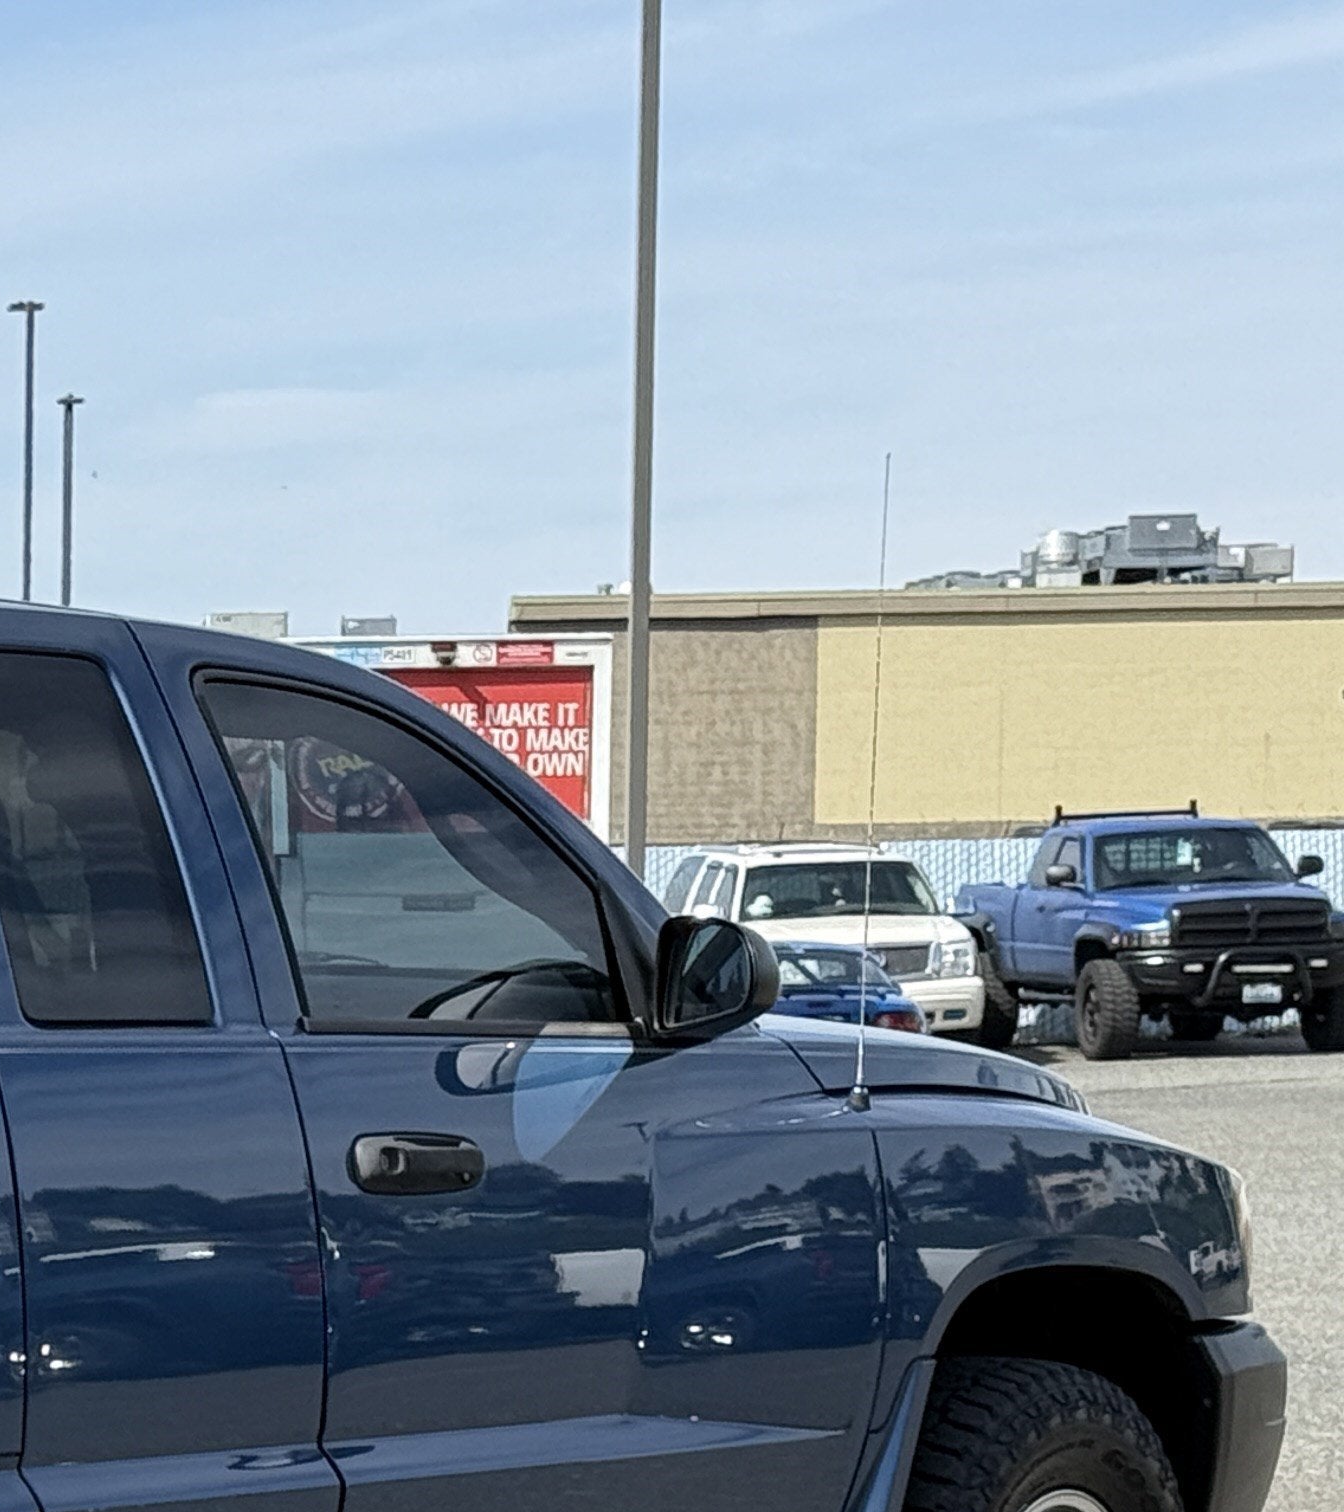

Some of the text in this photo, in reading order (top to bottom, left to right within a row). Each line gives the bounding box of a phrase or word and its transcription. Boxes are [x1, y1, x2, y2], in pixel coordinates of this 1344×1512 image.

[441, 702, 580, 727] WE MAKE IT
[488, 728, 520, 751] TO
[525, 728, 590, 751] MAKE
[527, 752, 584, 777] OWN
